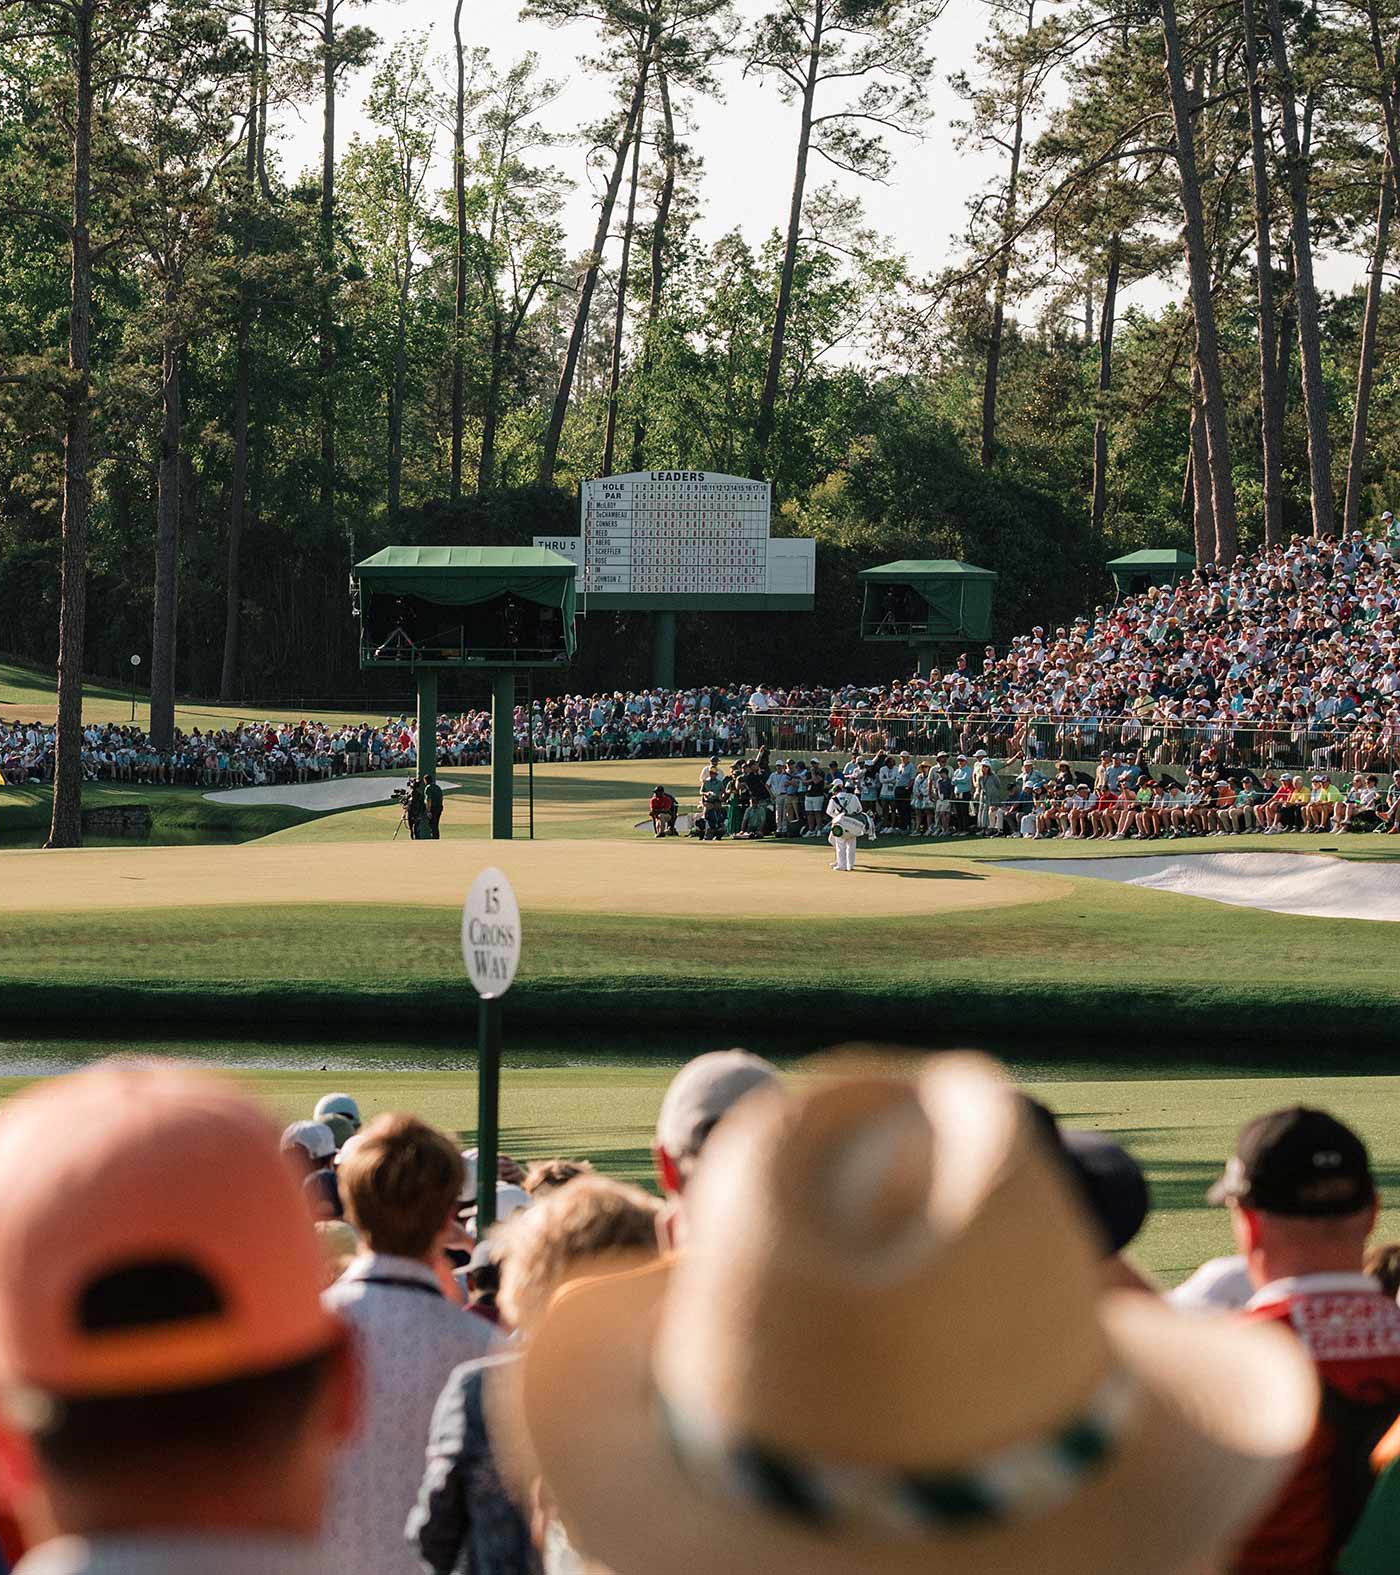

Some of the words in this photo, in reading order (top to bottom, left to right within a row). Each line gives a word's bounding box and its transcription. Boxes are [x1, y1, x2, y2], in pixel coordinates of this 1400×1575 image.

[651, 472, 704, 481] LEADERS
[538, 541, 566, 550] THRU
[570, 542, 576, 550] 5
[485, 887, 500, 914] 15
[469, 918, 515, 946] CROSS
[474, 950, 510, 980] WAY
